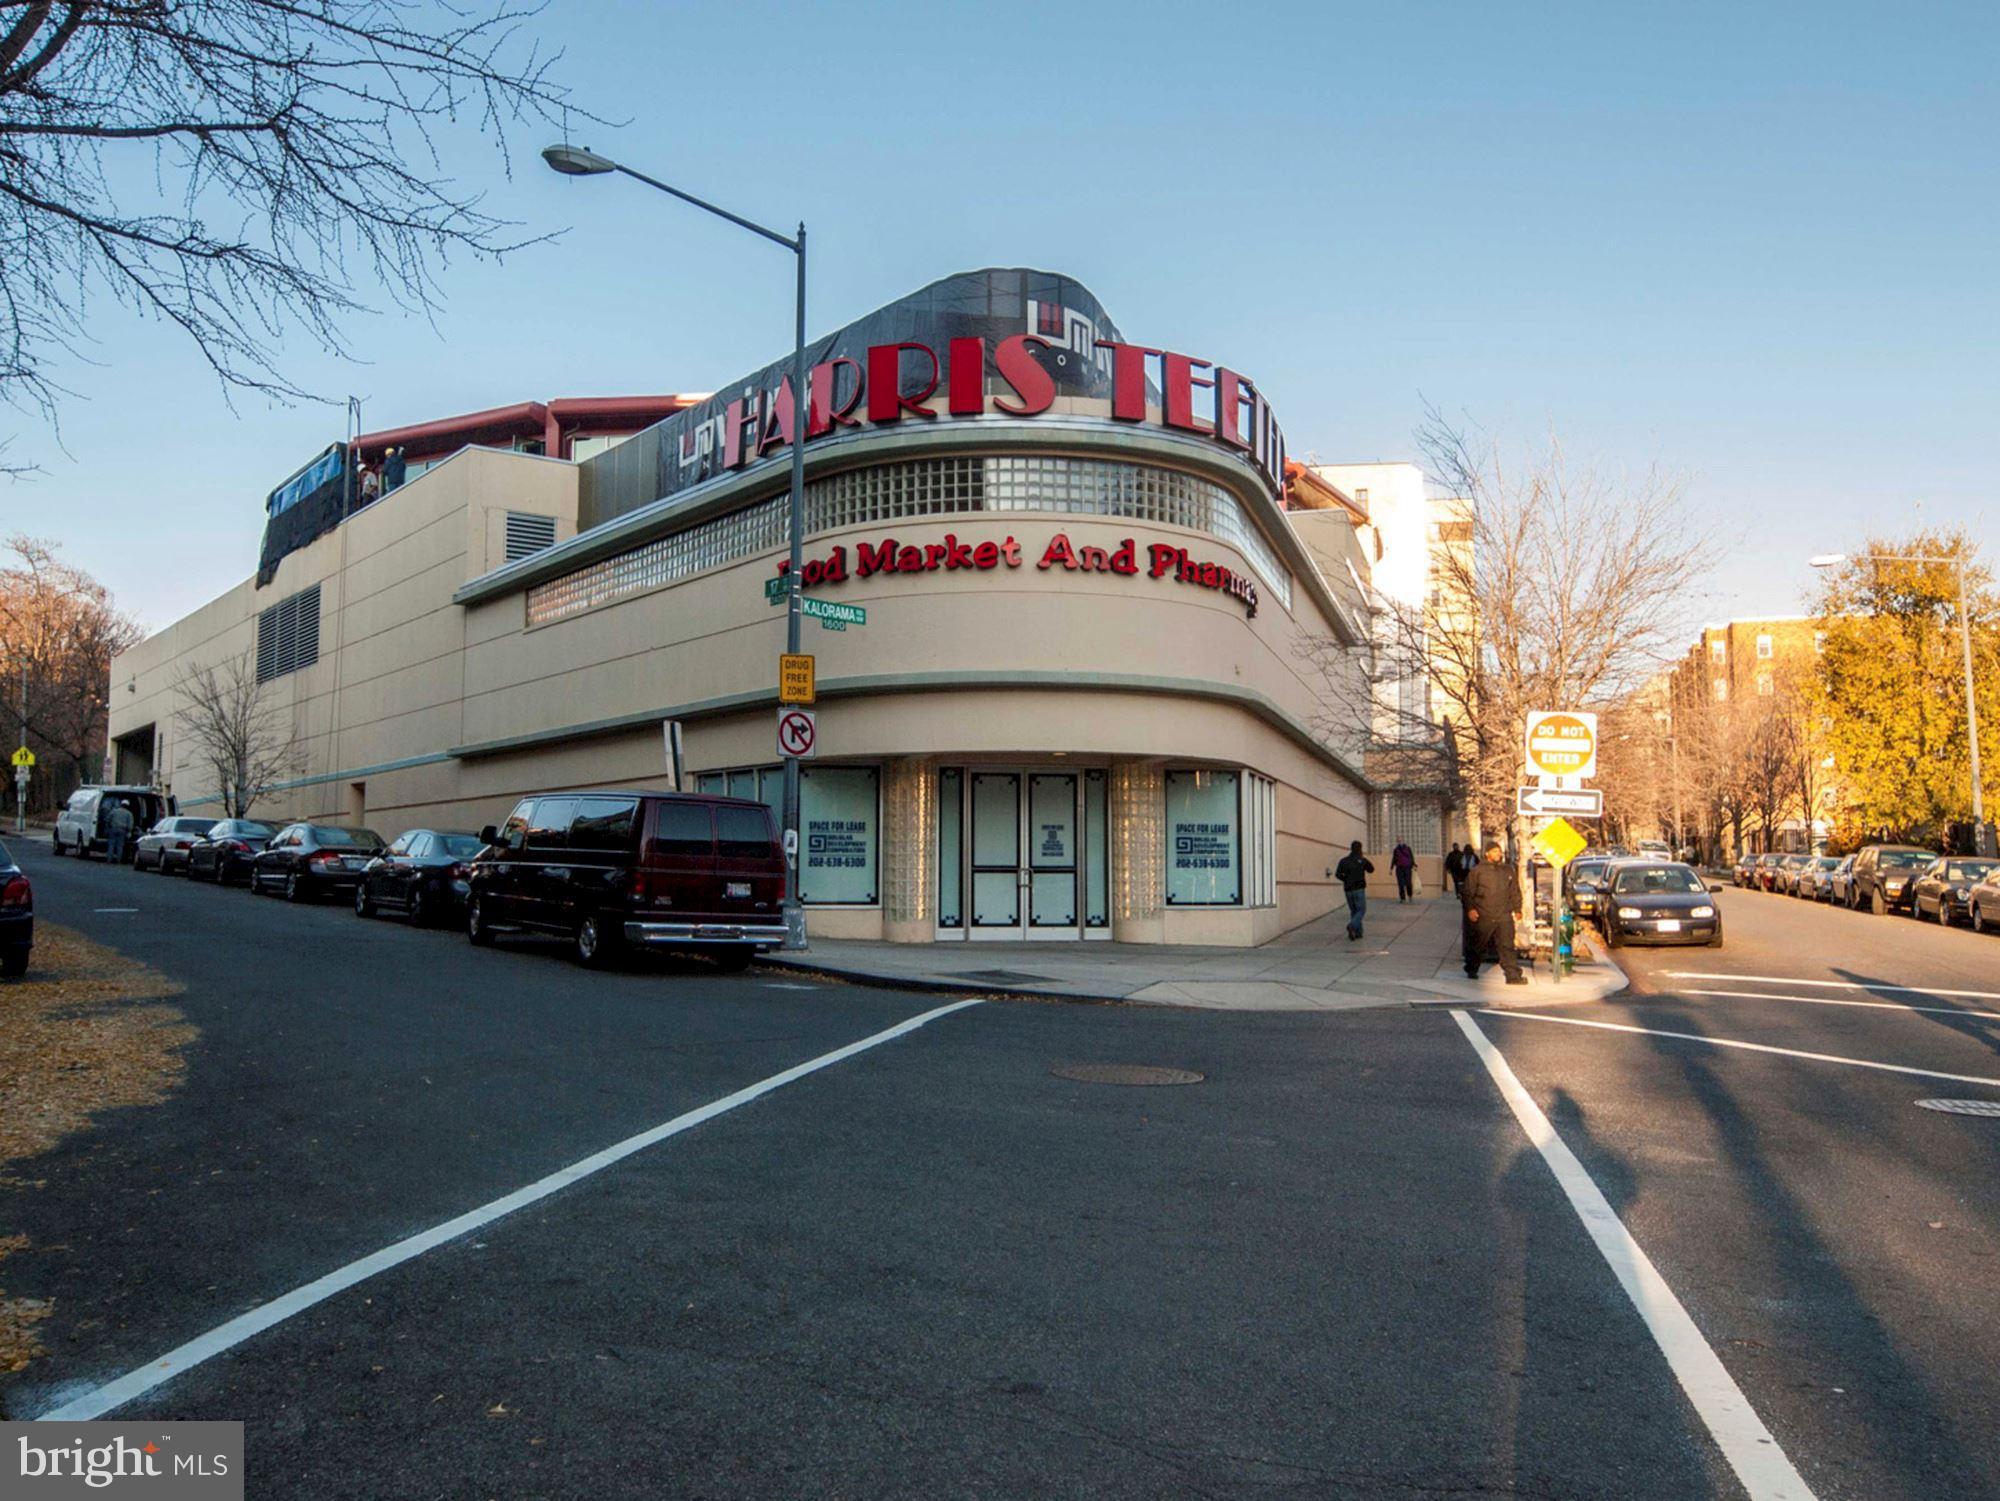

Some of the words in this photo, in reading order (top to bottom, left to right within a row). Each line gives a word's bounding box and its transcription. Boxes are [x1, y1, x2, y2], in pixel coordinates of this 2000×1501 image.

[724, 334, 1056, 470] HARRIS
[856, 534, 1022, 577] Market
[1036, 532, 1138, 577] And
[803, 600, 855, 622] KALORAMA
[823, 619, 845, 630] 1600
[785, 660, 809, 670] DRUG
[786, 673, 809, 683] FREE
[787, 686, 808, 696] ZONE
[1537, 725, 1555, 736] DO
[1561, 725, 1585, 737] NOT
[1541, 752, 1580, 764] ENTER
[809, 821, 829, 830] SPACE
[831, 821, 844, 830] FOR
[846, 821, 866, 831] LEASE
[1176, 824, 1195, 833] SPACE
[1197, 824, 1209, 832] FOR
[1210, 824, 1229, 833] LEASE
